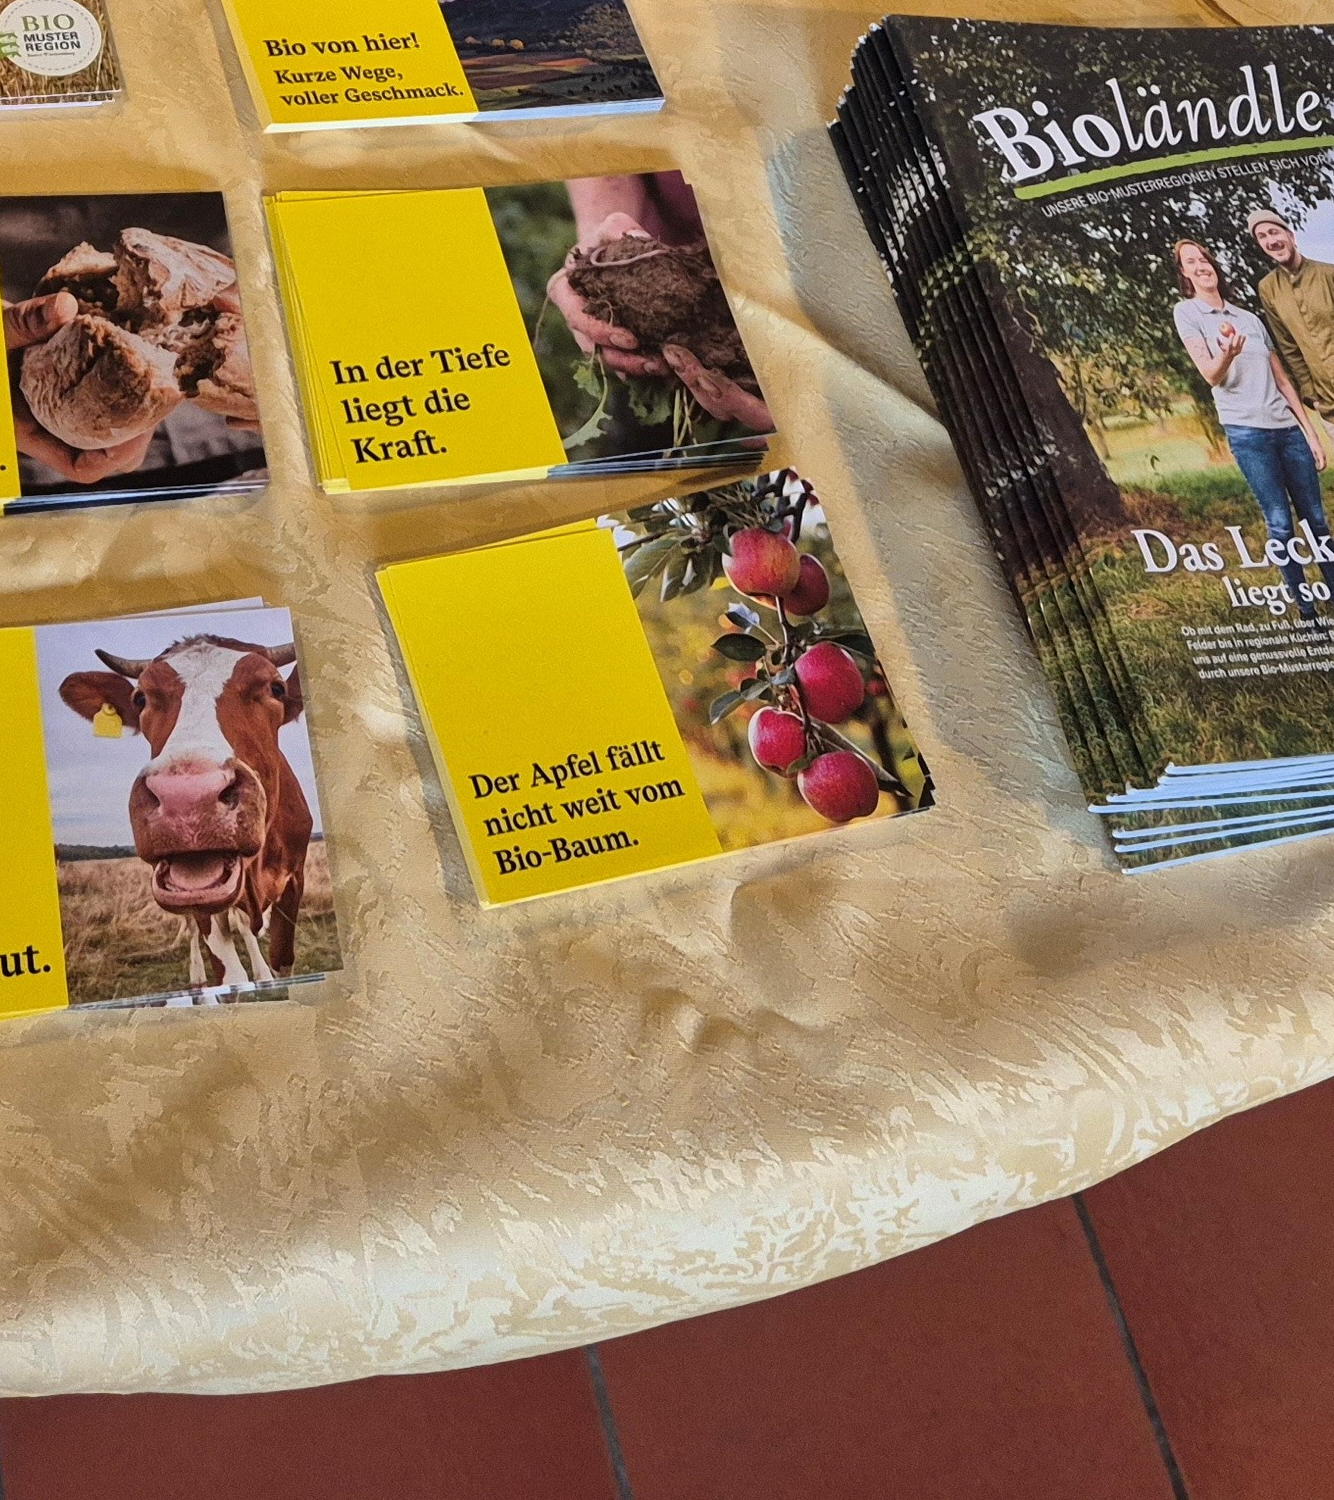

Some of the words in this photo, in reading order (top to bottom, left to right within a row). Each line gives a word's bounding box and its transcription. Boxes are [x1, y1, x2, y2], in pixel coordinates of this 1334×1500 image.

[263, 36, 307, 58] Bio
[311, 38, 358, 54] von
[362, 31, 421, 53] hier!
[275, 66, 337, 85] Kurze
[340, 63, 403, 87] Wege,
[281, 87, 340, 107] voller
[344, 81, 465, 106] Geschmack.
[972, 63, 1324, 185] Bioländle
[1040, 194, 1089, 218] UNSERE
[1088, 168, 1218, 205] BIO-MUSTERREGIONEN
[1218, 161, 1268, 180] STELLEN
[1269, 157, 1299, 171] SICH
[329, 358, 369, 386] In
[375, 354, 424, 382] der
[430, 342, 512, 375] Tiefe
[340, 394, 418, 428] liegt
[423, 386, 471, 415] die
[351, 428, 448, 464] Kraft.
[1129, 528, 1223, 575] Das
[1222, 575, 1292, 617] liegt
[1297, 579, 1332, 602] so
[1198, 668, 1227, 680] durch
[1228, 666, 1260, 678] unsere
[468, 770, 520, 799] Der
[530, 750, 603, 792] Apfel
[606, 737, 666, 772] fällt
[483, 802, 559, 837] nicht
[561, 785, 620, 820] weit
[624, 775, 686, 805] vom
[493, 835, 640, 876] Bio-Baum.
